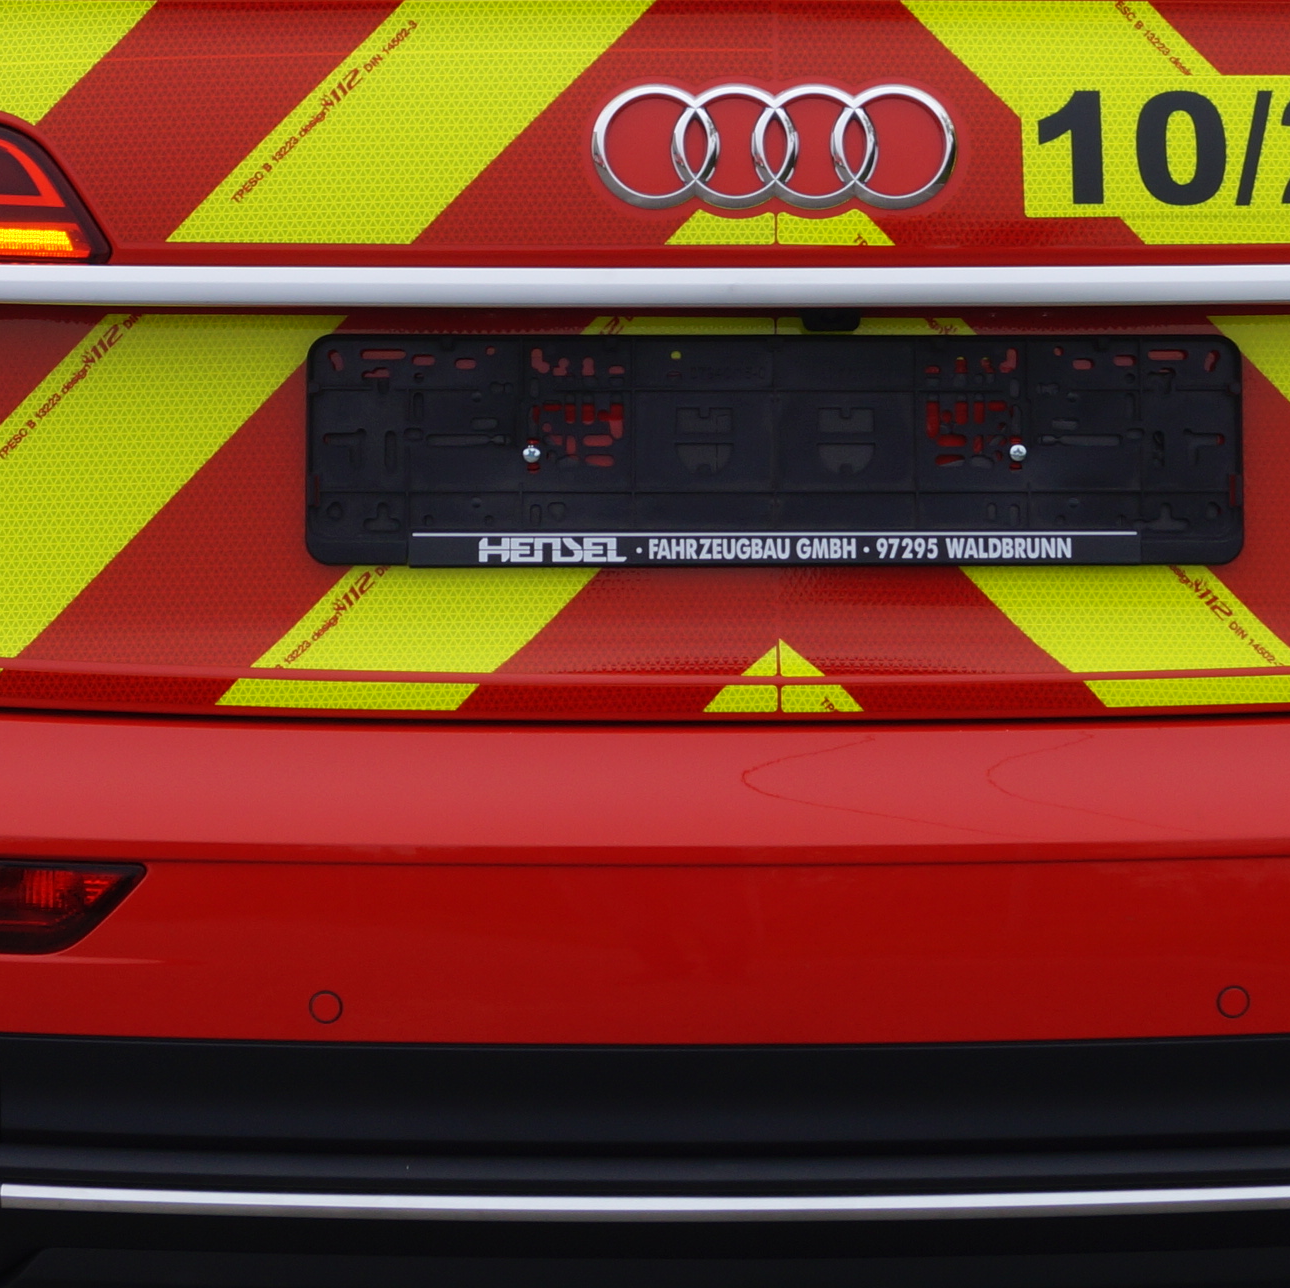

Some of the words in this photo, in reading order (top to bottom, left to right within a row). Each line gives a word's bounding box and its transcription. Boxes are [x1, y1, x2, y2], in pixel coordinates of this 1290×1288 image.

[230, 171, 264, 204] TPESC
[261, 162, 273, 173] B
[271, 135, 299, 163] 13223
[363, 53, 384, 73] DIN
[382, 19, 418, 54] 14502-3
[26, 419, 37, 430] B
[34, 392, 62, 420] 13223
[478, 537, 628, 563] HENSEL
[648, 538, 791, 560] FAHRZEUGBAU
[796, 537, 857, 560] GMBH
[875, 537, 939, 559] 97295
[945, 537, 1073, 559] WALDBRUNN
[1228, 620, 1249, 640] DIN
